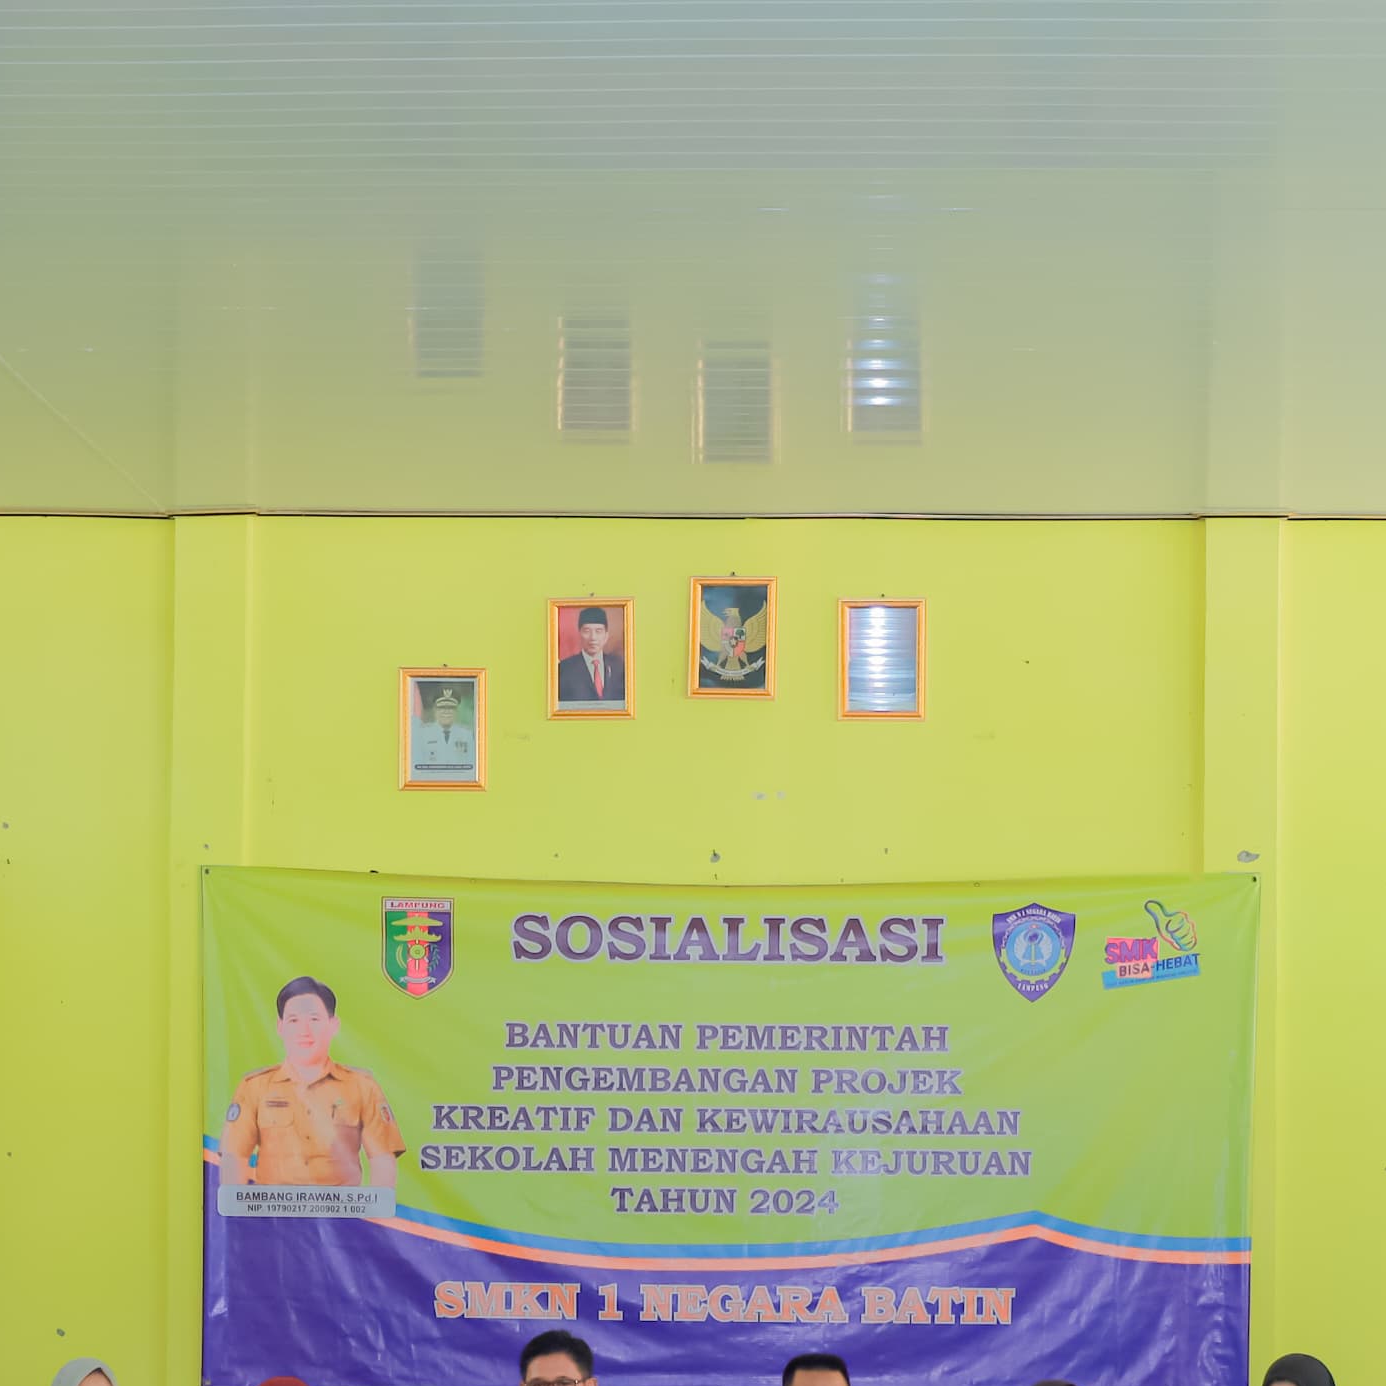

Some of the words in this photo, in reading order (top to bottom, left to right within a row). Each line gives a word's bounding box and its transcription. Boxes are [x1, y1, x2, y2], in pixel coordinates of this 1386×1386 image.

[389, 901, 446, 909] LAMPUNG
[511, 912, 947, 964] SOSIALISASI
[1104, 937, 1158, 965] SMK
[505, 1022, 684, 1050] BANTUAN
[694, 1024, 950, 1052] PEMERINTAH
[491, 1065, 799, 1094] PENGEMBANGAN
[811, 1068, 963, 1096] PROJEK
[431, 1105, 596, 1132] KREATIF
[607, 1107, 684, 1133] DAN
[695, 1107, 1022, 1136] KEWIRAUSAHAAN
[419, 1145, 596, 1172] SEKOLAH
[607, 1147, 819, 1175] MENENGAH
[830, 1149, 1033, 1177] KEJURUAN
[236, 1191, 293, 1202] BAMBANG
[266, 1205, 307, 1214] 19790217
[610, 1187, 738, 1215] TAHUN
[749, 1189, 840, 1216] 2024
[433, 1280, 580, 1321] SMKN
[598, 1283, 623, 1321] 1
[639, 1284, 847, 1324] NEGARA
[861, 1286, 1016, 1325] BATIN
